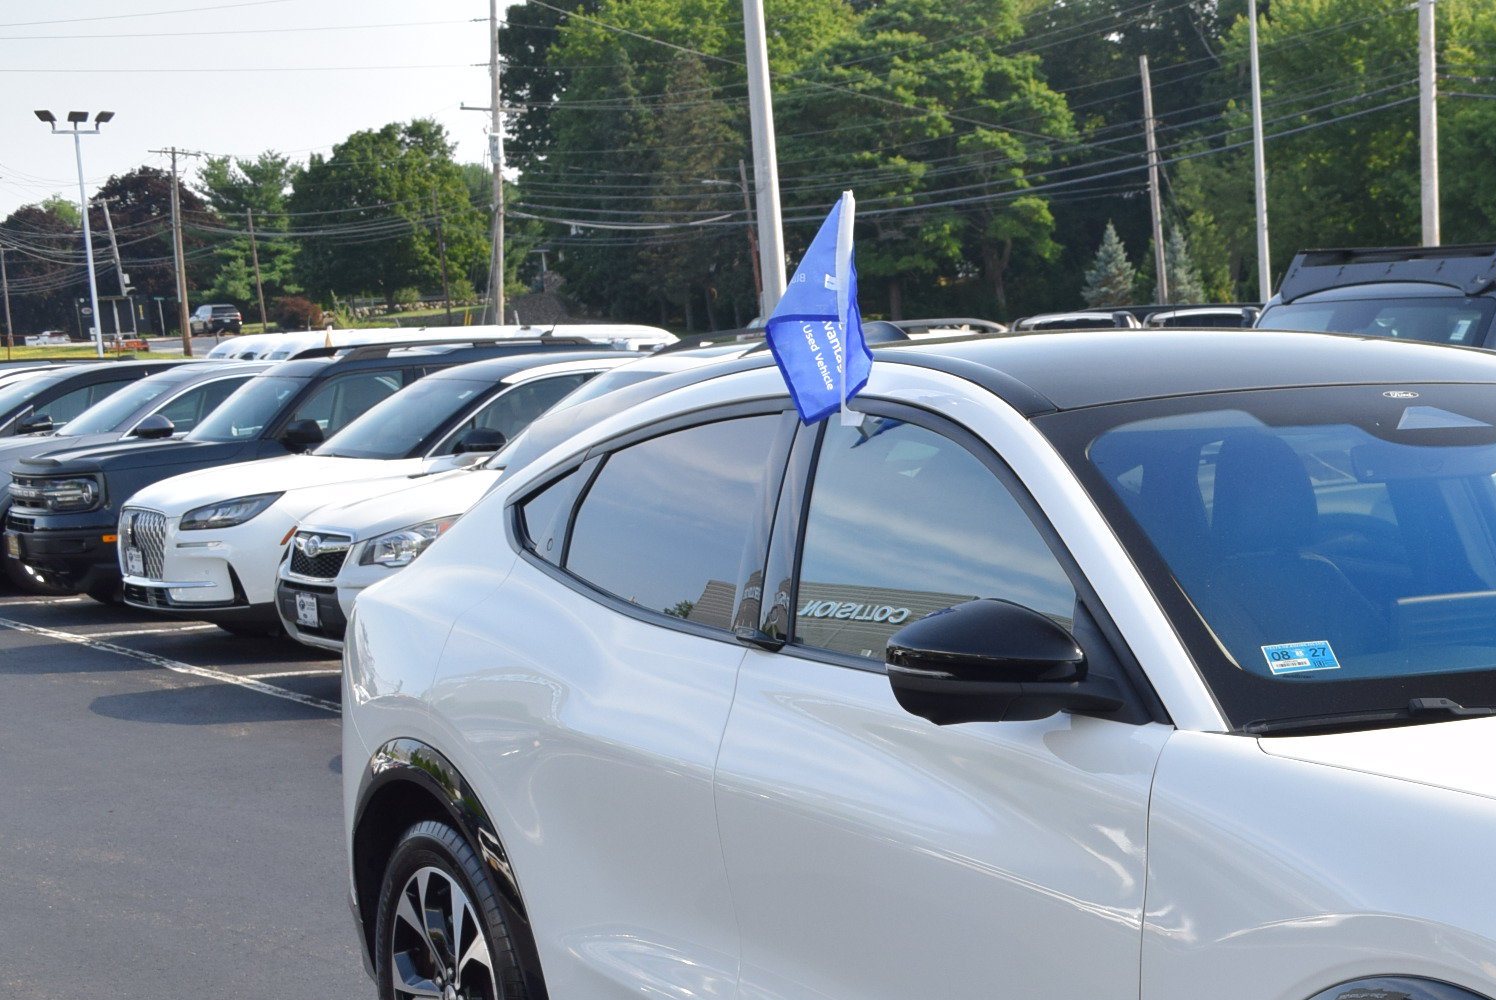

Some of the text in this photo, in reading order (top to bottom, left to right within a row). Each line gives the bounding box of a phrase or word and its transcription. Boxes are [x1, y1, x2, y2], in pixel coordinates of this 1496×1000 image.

[803, 324, 834, 390] Used Vehicle
[1271, 647, 1327, 661] 08 27
